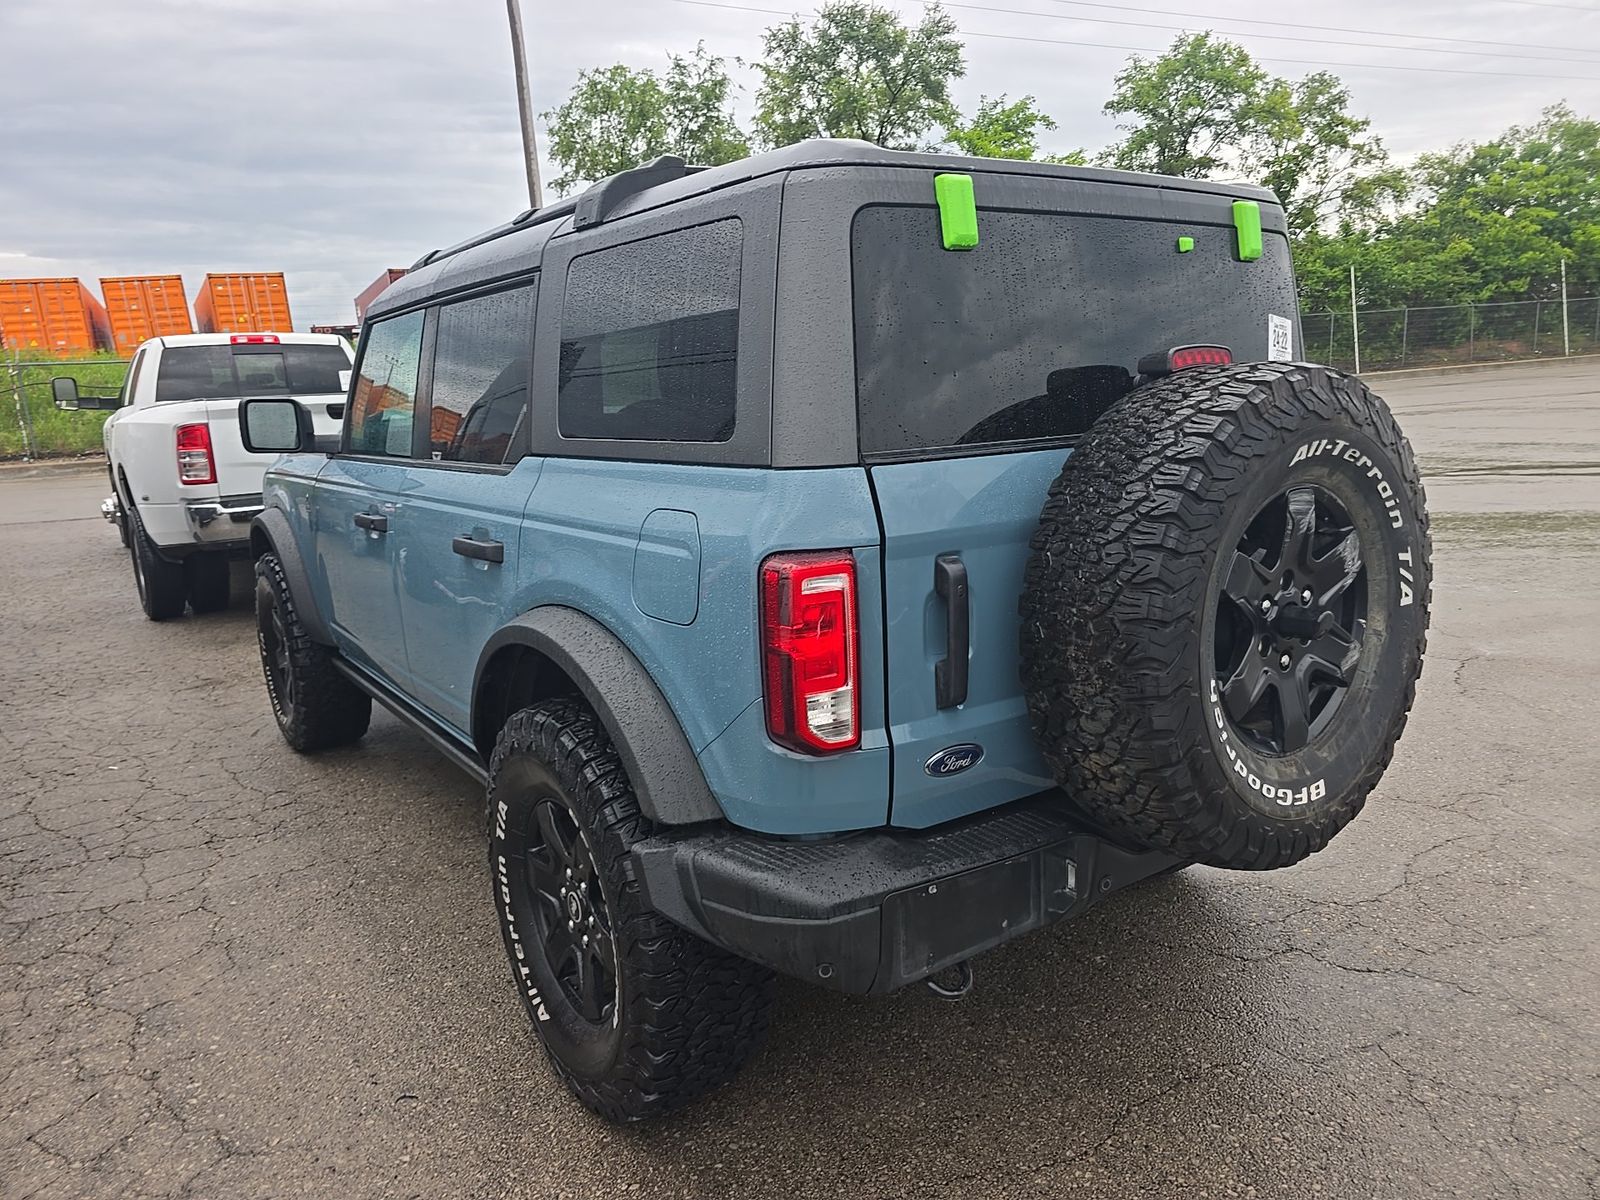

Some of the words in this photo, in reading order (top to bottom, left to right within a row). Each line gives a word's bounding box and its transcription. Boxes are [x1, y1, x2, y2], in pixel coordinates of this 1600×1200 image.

[1289, 439, 1404, 529] All-Terrain
[1397, 546, 1414, 607] T/A
[940, 753, 973, 773] Ford
[495, 800, 508, 840] T/A
[498, 855, 551, 1022] All-Terrain
